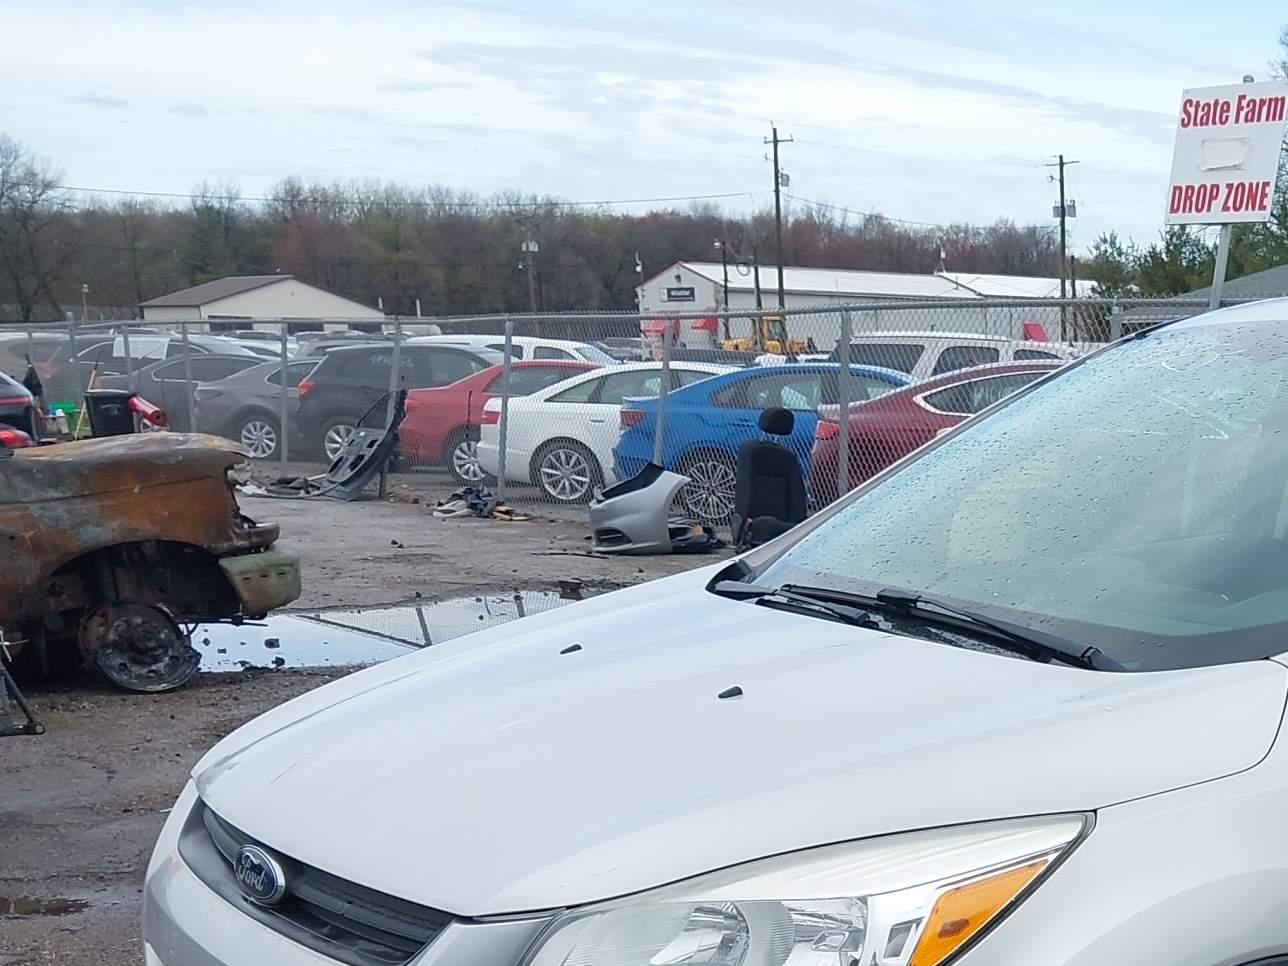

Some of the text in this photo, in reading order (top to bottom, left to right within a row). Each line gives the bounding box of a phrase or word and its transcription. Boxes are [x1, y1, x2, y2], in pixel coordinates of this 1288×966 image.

[1181, 94, 1286, 129] State Farm
[1169, 181, 1271, 214] DROP ZONE
[239, 851, 266, 892] Ford
